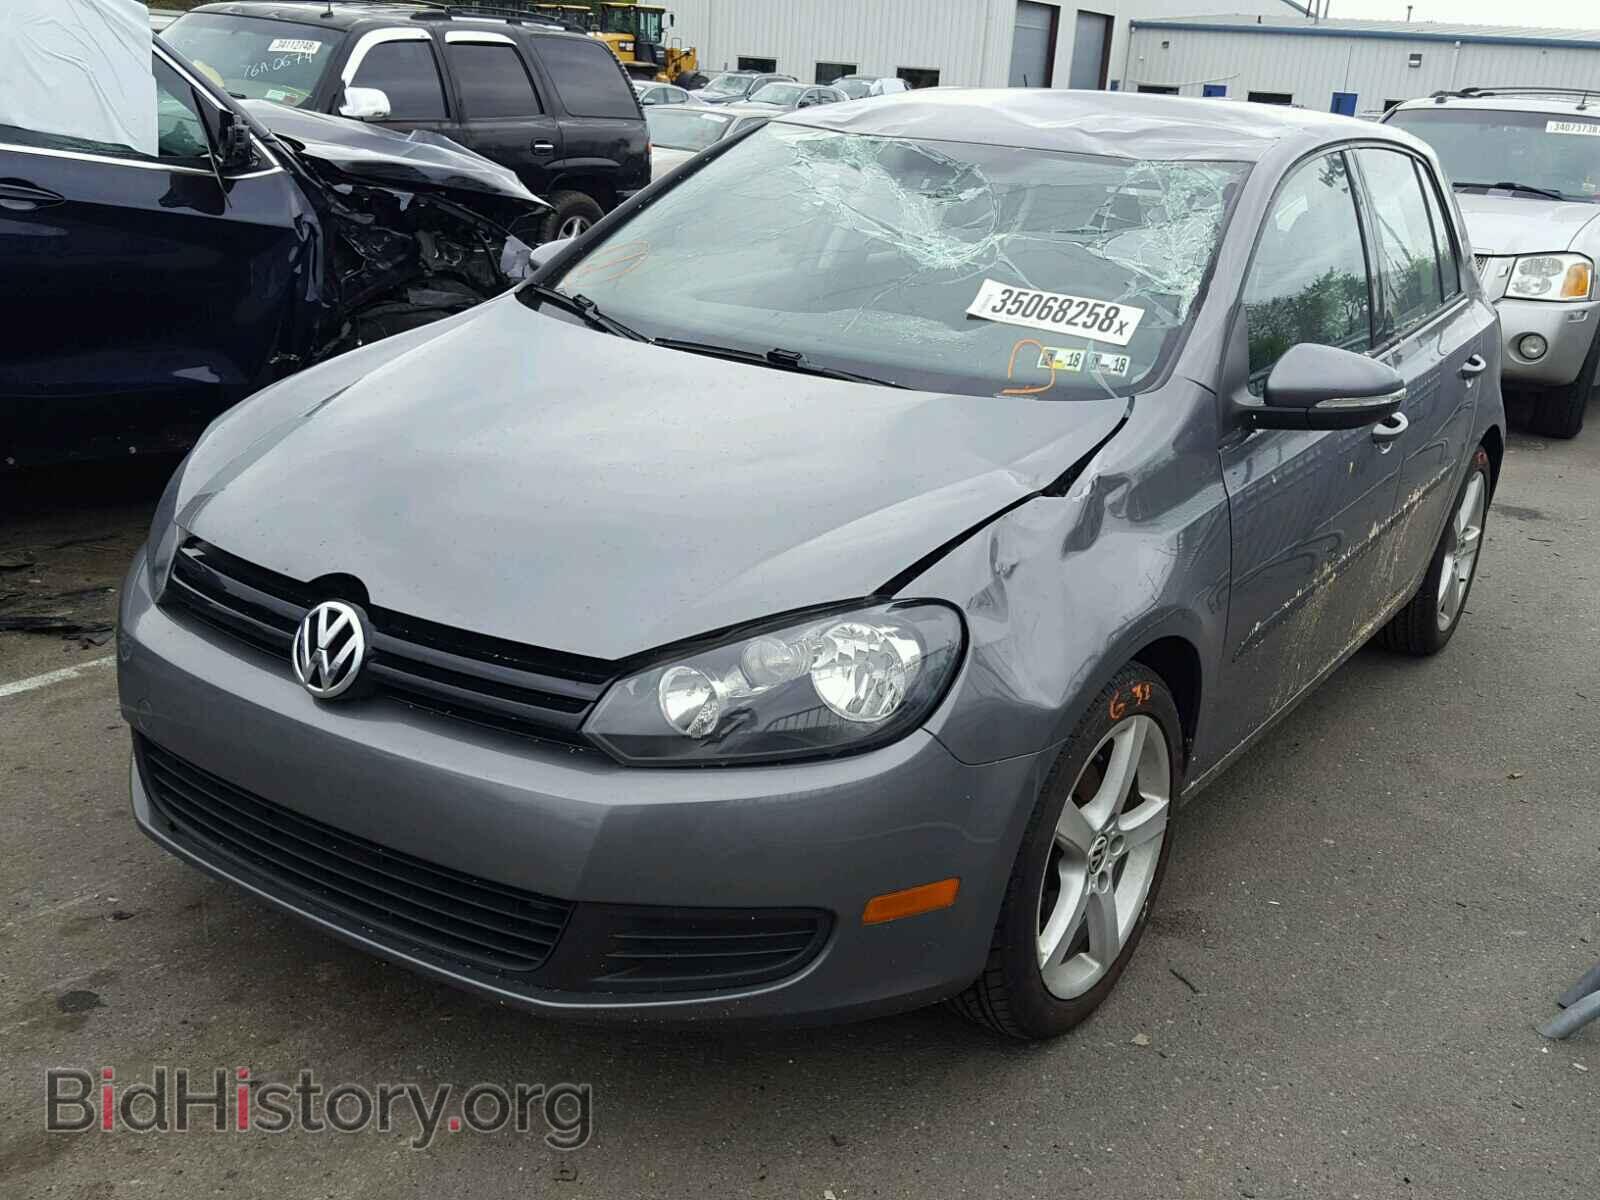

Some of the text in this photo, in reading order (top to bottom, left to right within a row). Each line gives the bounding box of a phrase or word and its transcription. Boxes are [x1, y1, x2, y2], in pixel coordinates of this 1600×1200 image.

[1066, 352, 1082, 368] 18
[1112, 356, 1127, 373] 18
[293, 601, 365, 698] VW
